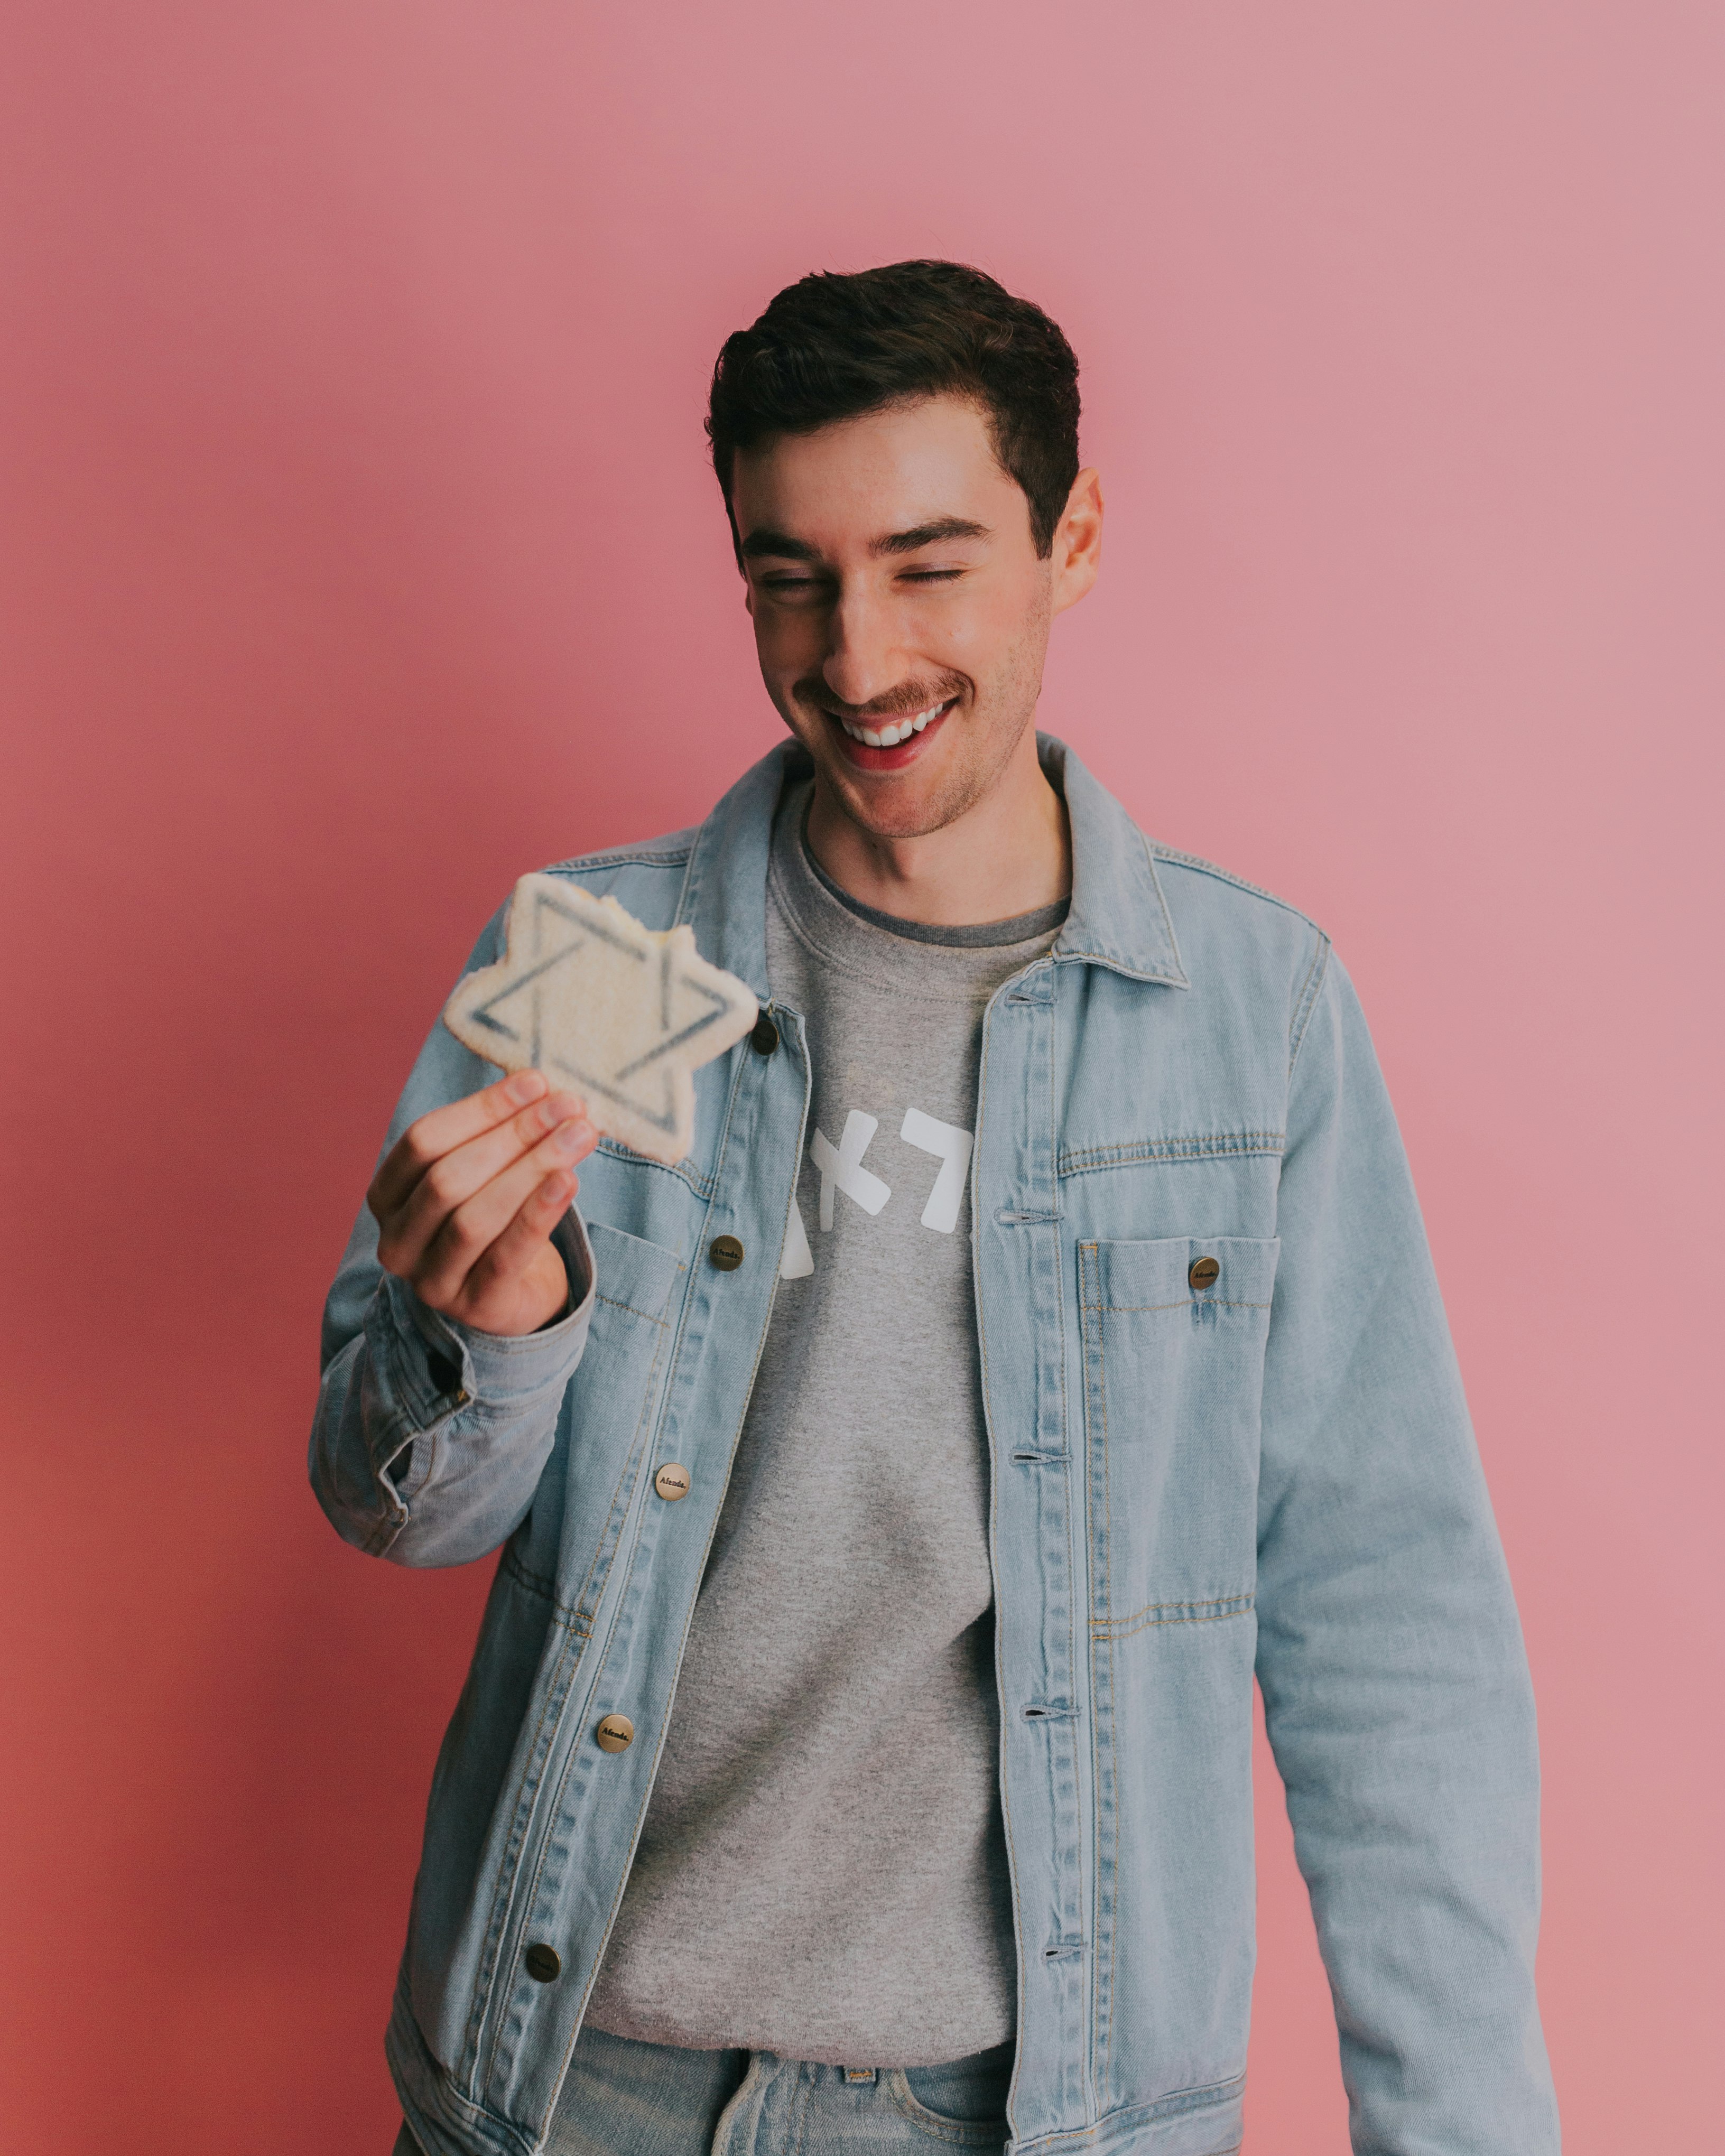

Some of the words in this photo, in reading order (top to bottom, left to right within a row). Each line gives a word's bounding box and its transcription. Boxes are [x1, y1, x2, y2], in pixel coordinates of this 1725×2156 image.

[780, 1107, 974, 1280] רא
[660, 1476, 687, 1489] Afends.
[601, 1726, 629, 1742] Afends.
